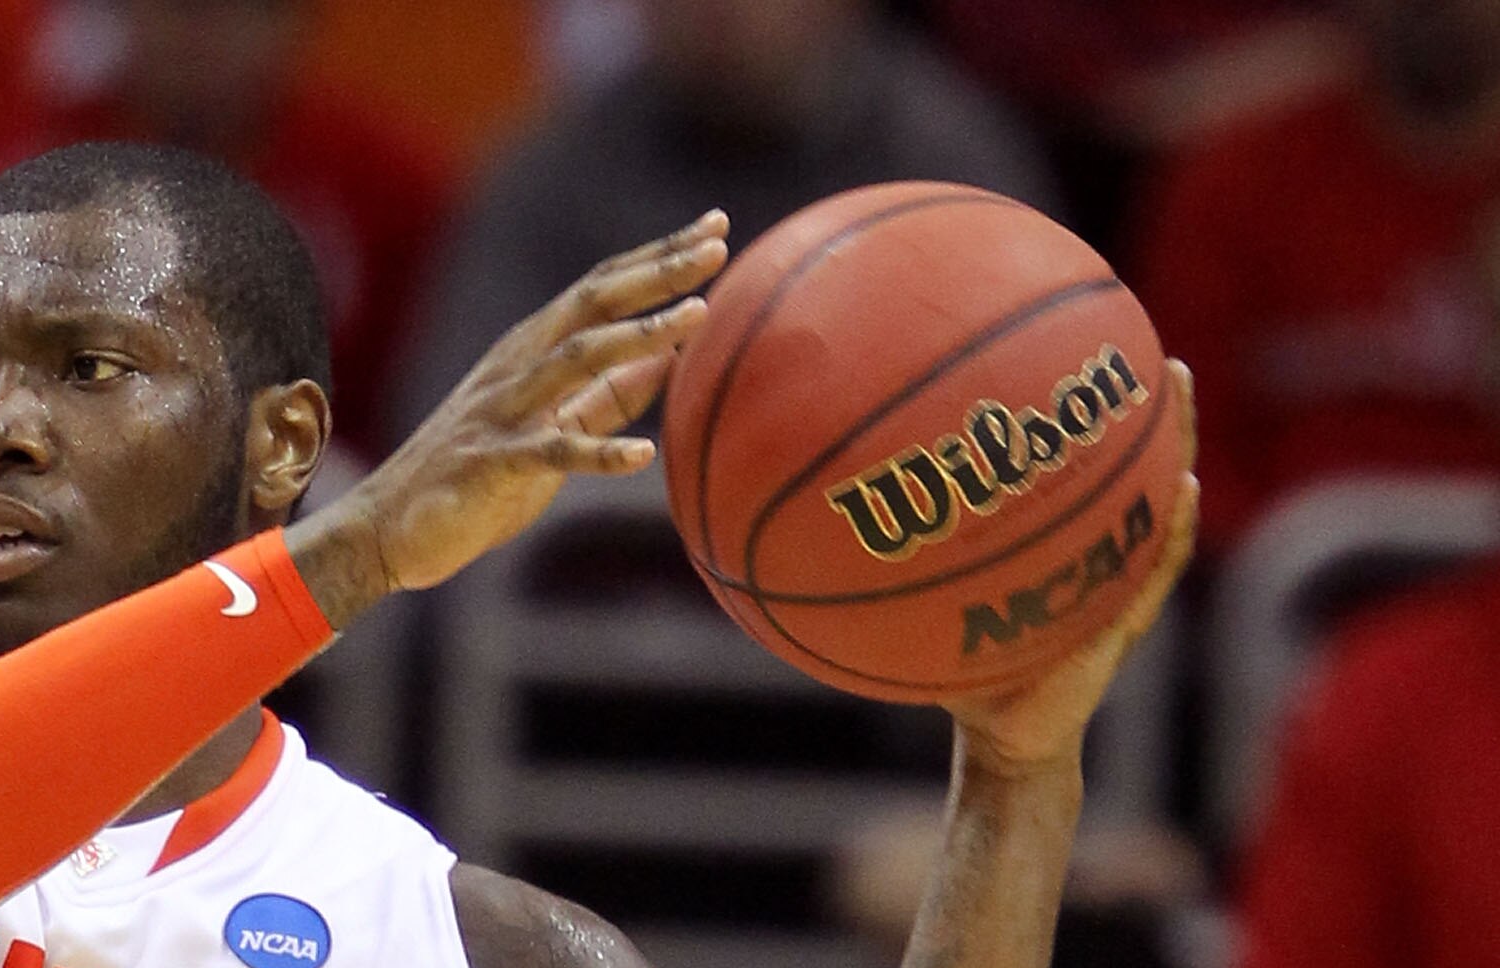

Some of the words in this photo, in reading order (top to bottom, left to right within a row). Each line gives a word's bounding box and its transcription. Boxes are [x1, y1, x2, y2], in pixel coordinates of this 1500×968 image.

[825, 343, 1149, 562] Wilson
[961, 493, 1154, 658] NCAA
[240, 929, 318, 962] NCAA
